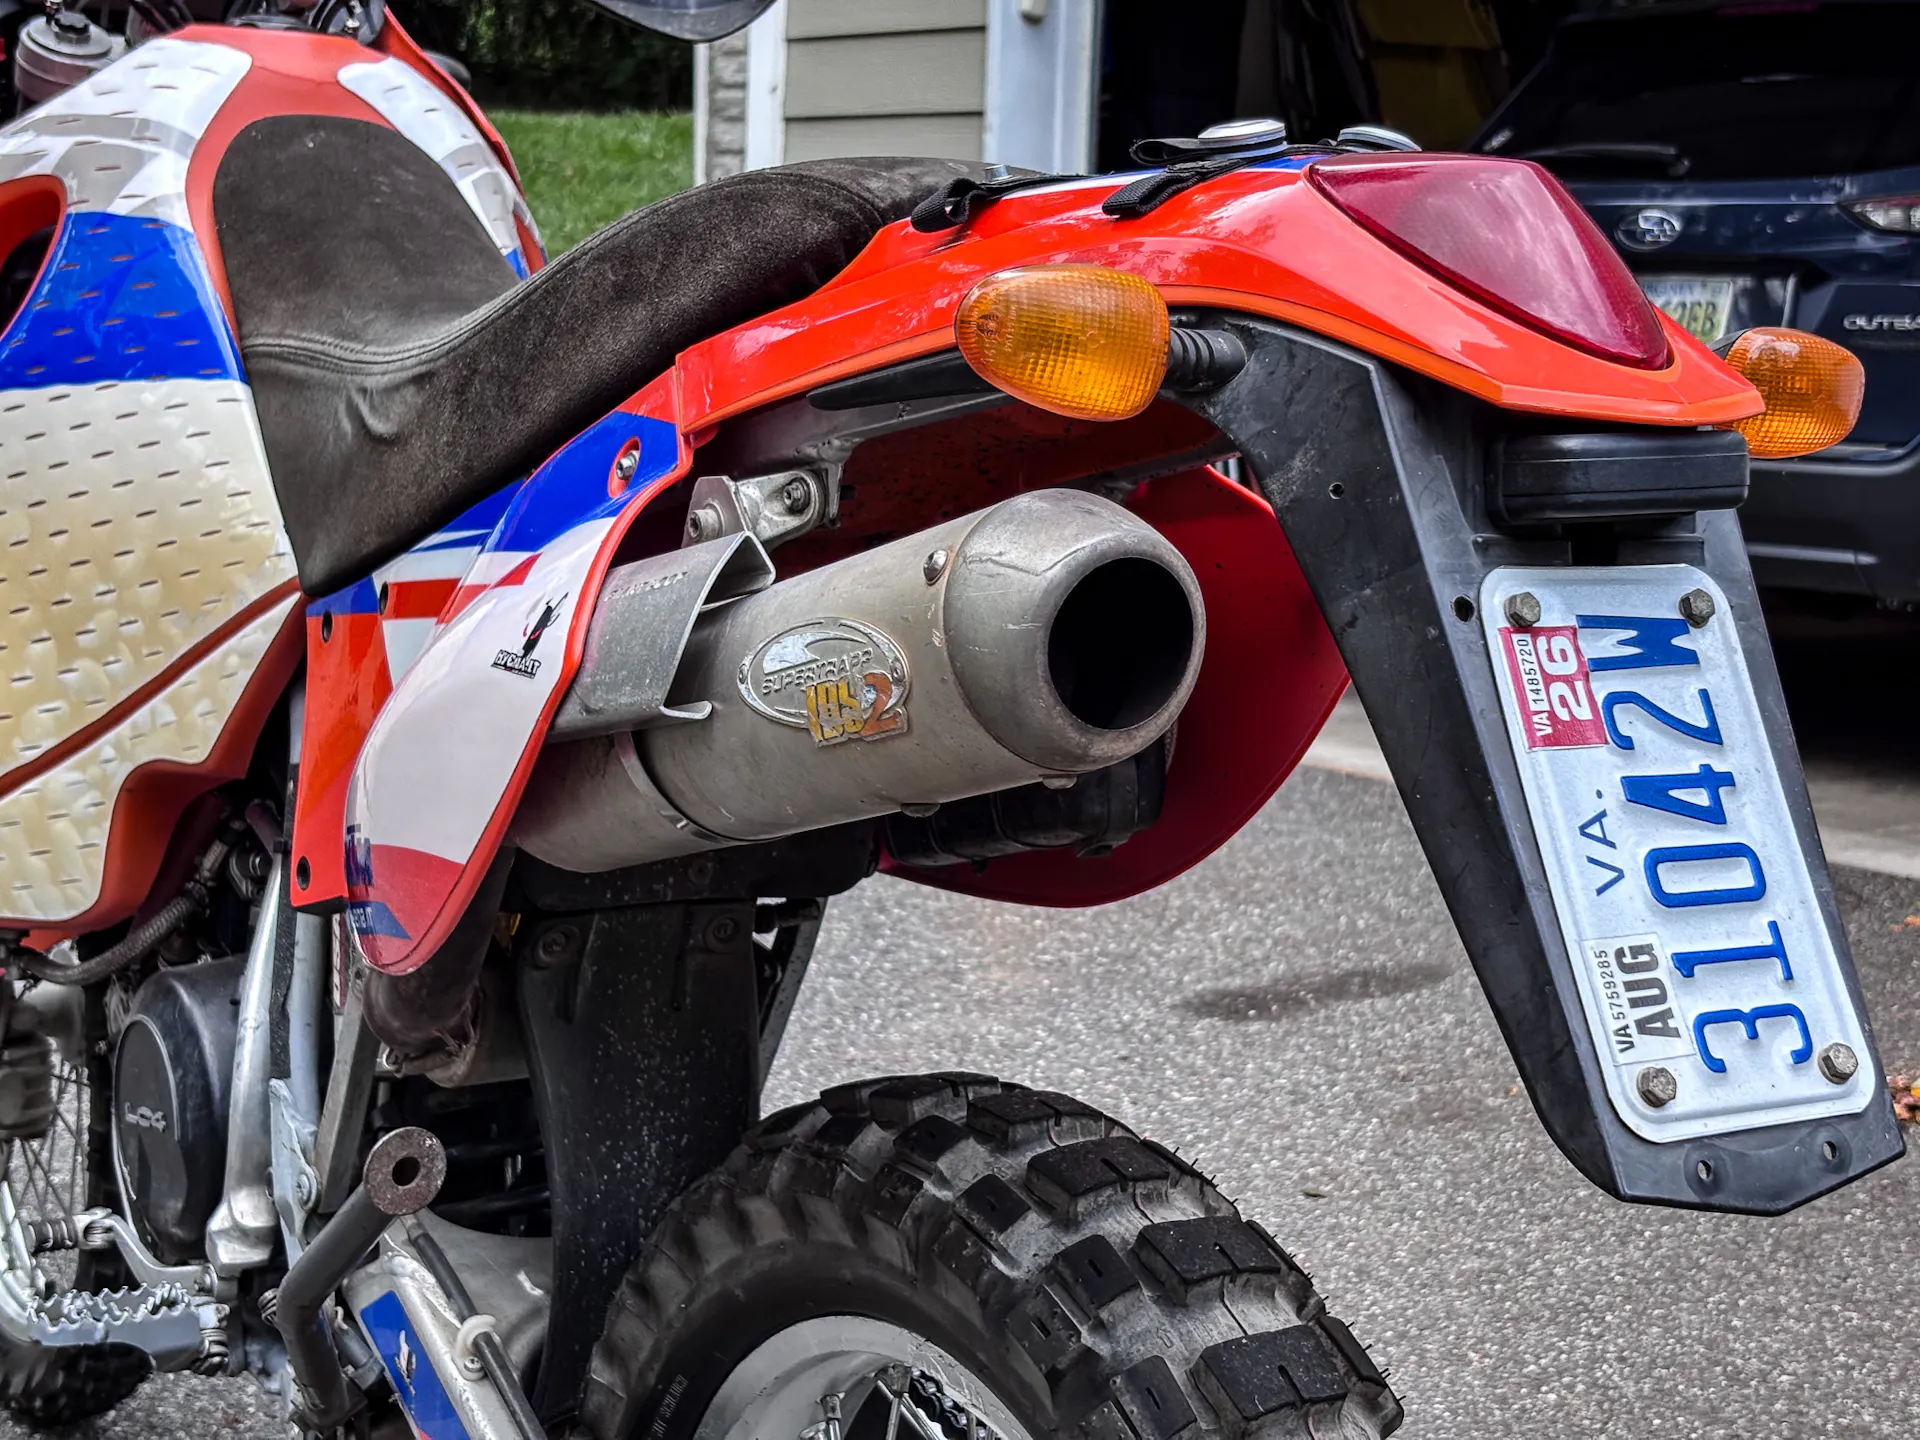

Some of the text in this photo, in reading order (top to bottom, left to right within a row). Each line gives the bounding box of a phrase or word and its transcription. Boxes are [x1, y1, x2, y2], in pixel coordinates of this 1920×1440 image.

[762, 647, 873, 695] SUPERTRAPP
[1516, 638, 1553, 737] VA 1485720
[1536, 635, 1594, 722] 26
[1575, 614, 1814, 1075] 31042W
[1578, 788, 1626, 897] VA.
[1593, 949, 1636, 1054] VA 5759285
[1614, 942, 1682, 1039] AUG
